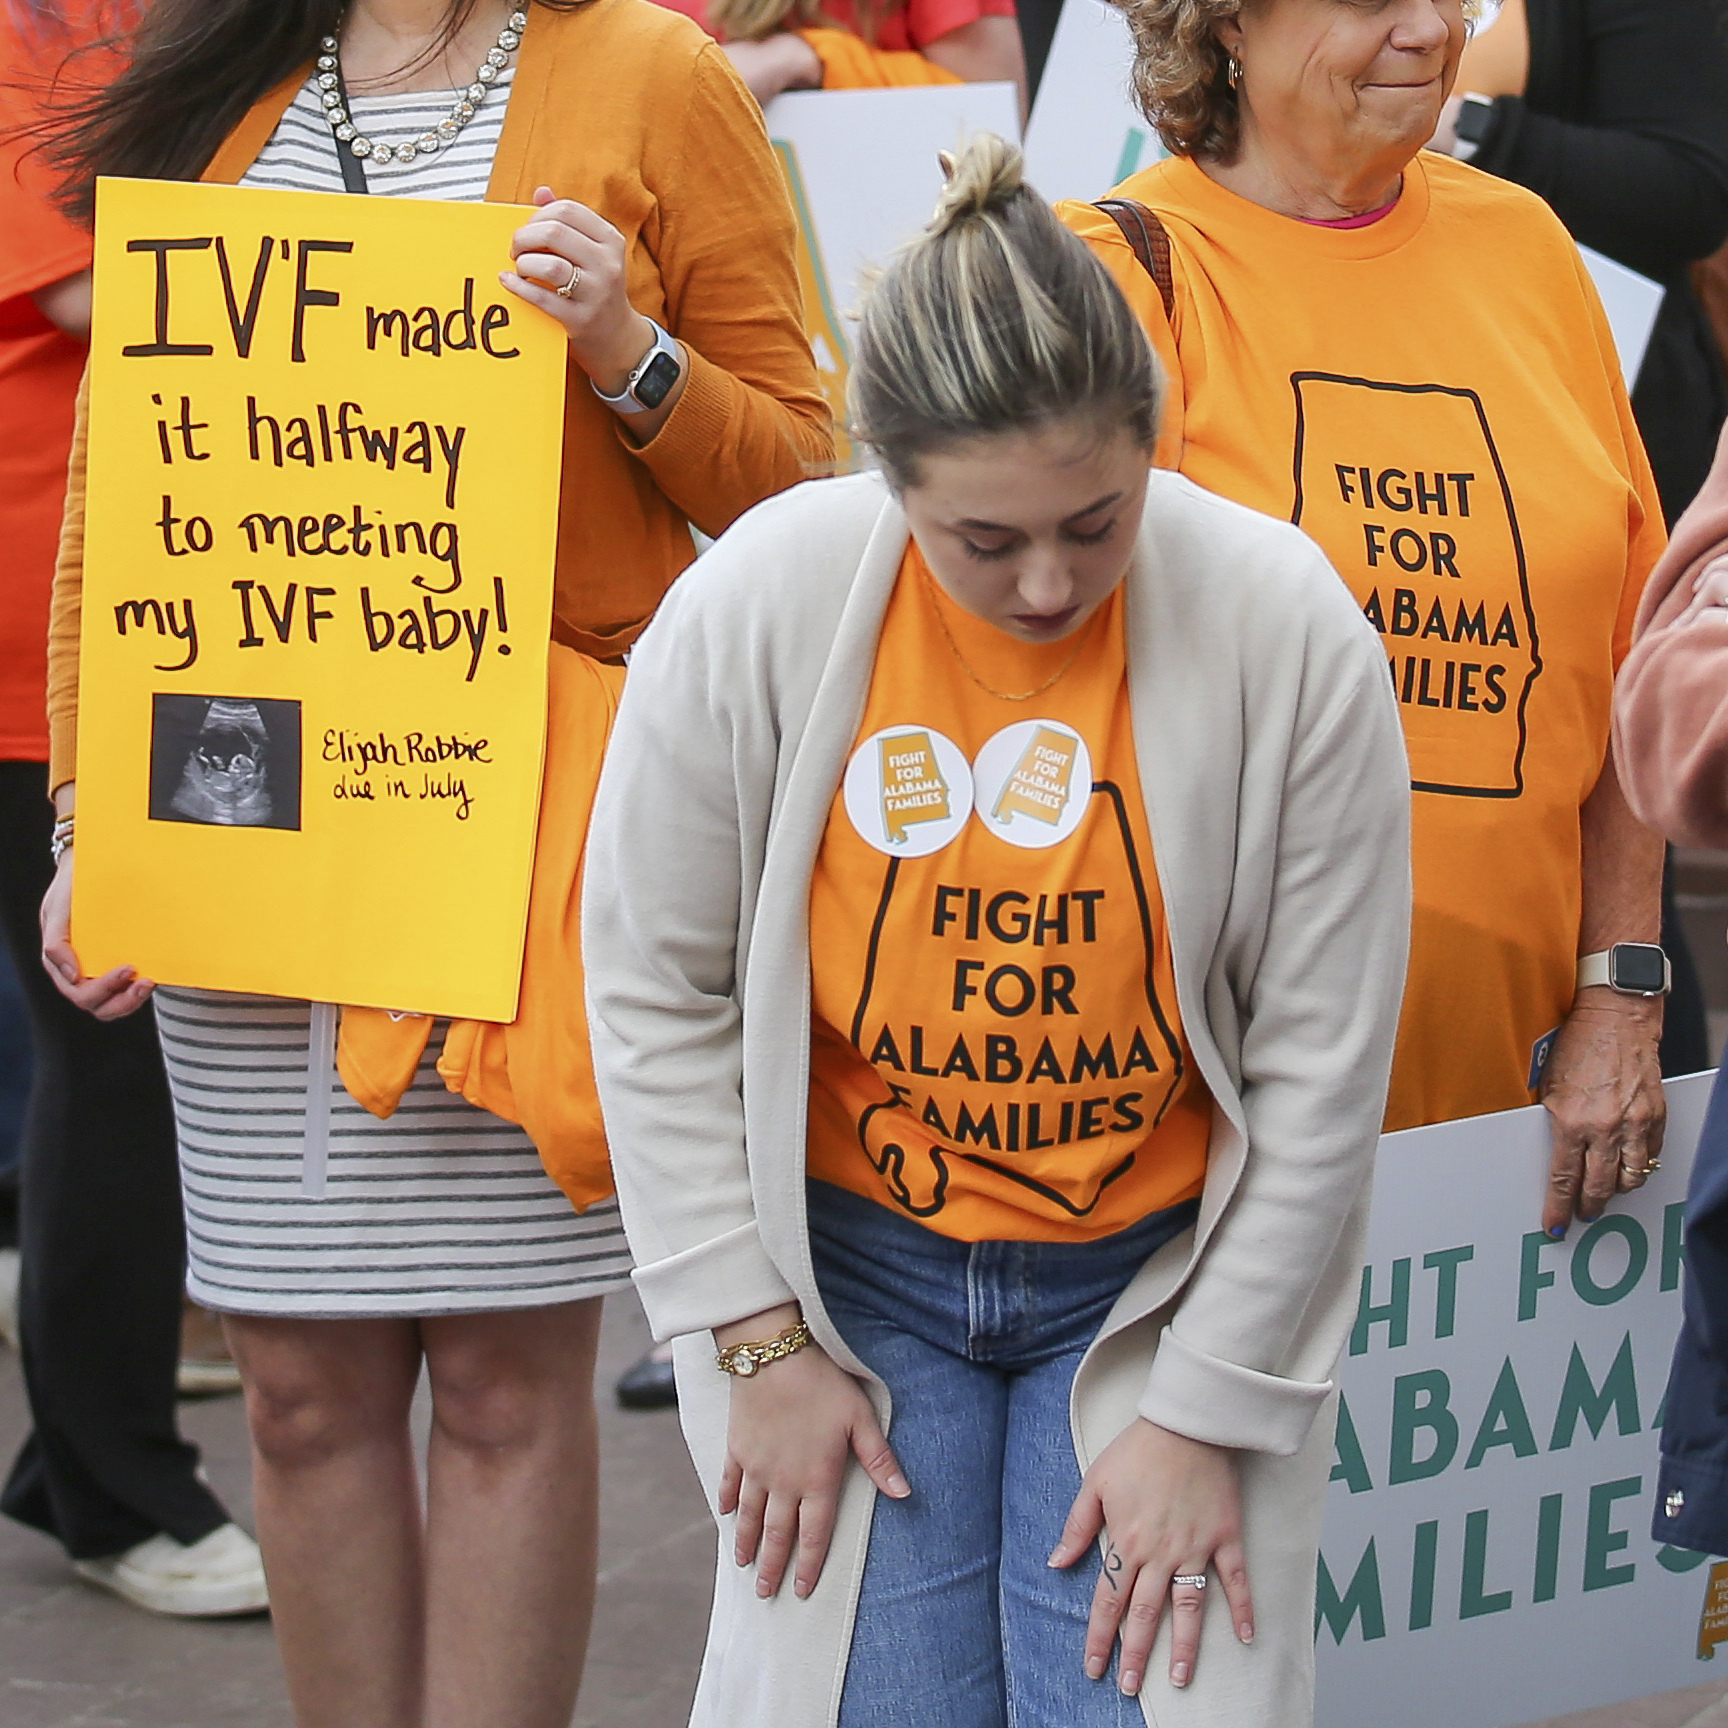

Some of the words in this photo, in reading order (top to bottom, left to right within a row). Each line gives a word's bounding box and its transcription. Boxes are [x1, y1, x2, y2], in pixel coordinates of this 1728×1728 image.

[365, 277, 521, 359] made
[151, 393, 211, 464] it
[246, 395, 466, 510] halfway
[1334, 463, 1475, 517] FIGHT
[156, 495, 213, 557] to
[237, 505, 462, 594] meeting
[1363, 523, 1462, 578] FOR
[114, 597, 199, 671] my
[232, 580, 336, 648] IVF
[361, 576, 512, 682] baby!
[322, 728, 406, 776] Elijah
[888, 750, 926, 768] FIGHT
[895, 766, 923, 781] FOR
[1033, 760, 1059, 779] FOR
[1034, 745, 1069, 766] FIGHT
[333, 774, 375, 800] due
[385, 774, 411, 798] in
[419, 772, 474, 821] July
[884, 779, 942, 798] ALABAMA
[886, 792, 942, 811] FAMILIES
[1009, 781, 1062, 809] FAMILIES
[1013, 770, 1067, 797] ALABAMA
[932, 884, 1105, 946] FIGHT
[952, 958, 1080, 1017] FOR
[870, 1022, 1160, 1084] ALABAMA
[1314, 1475, 1710, 1646] MILIE
